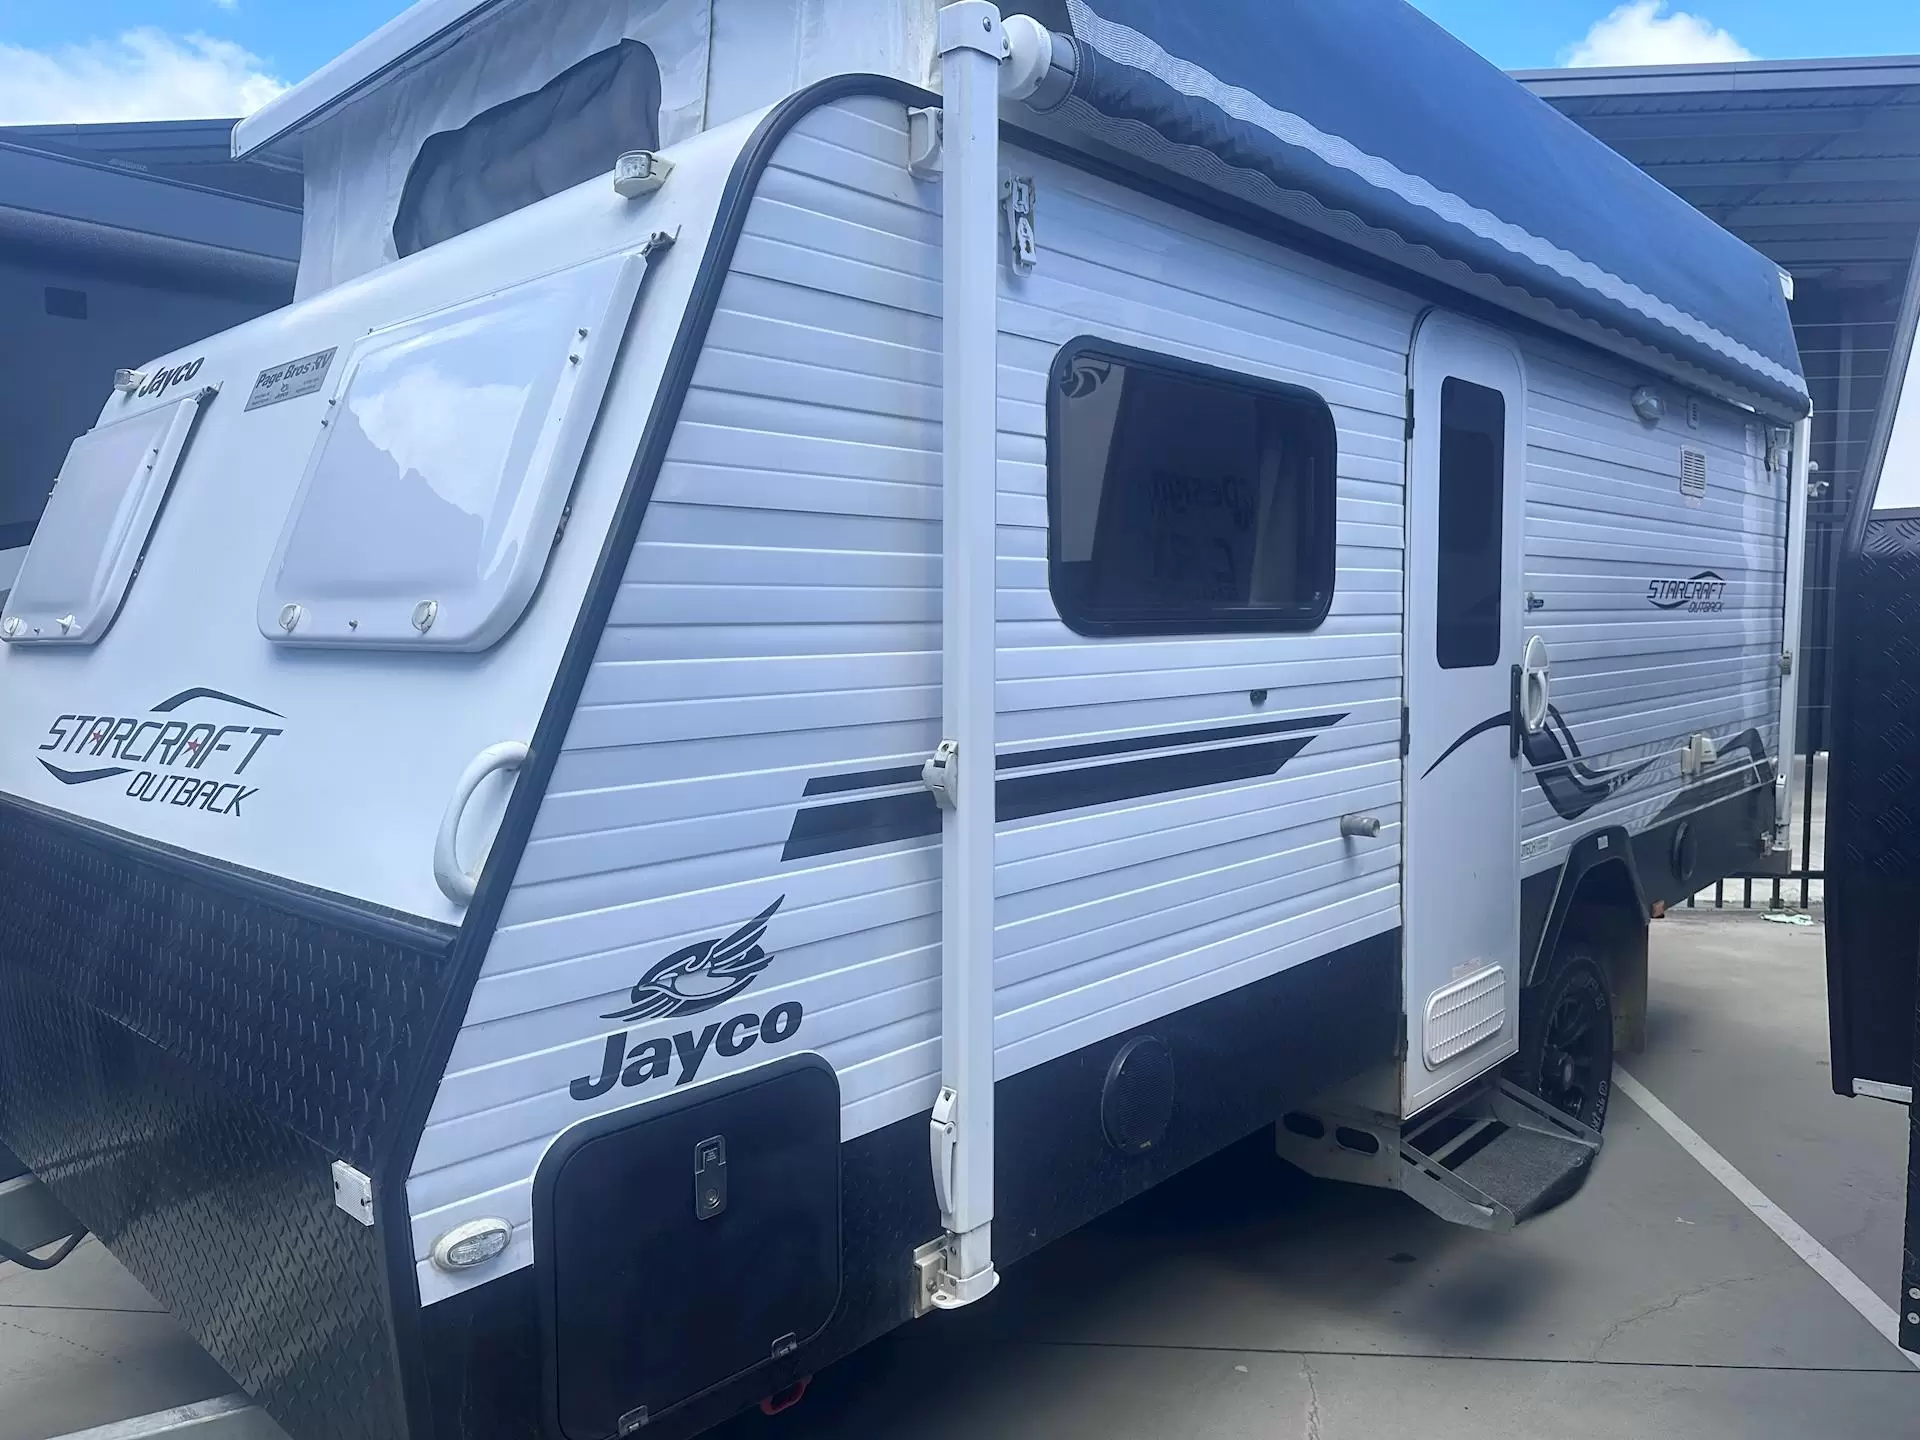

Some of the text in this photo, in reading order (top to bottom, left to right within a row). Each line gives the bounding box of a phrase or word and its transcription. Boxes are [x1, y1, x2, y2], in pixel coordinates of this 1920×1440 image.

[138, 357, 205, 398] Jayco
[256, 373, 283, 389] Page
[283, 364, 311, 381] Bros
[1646, 579, 1727, 600] STARCRAFT
[1688, 601, 1724, 613] OUTBACK
[38, 714, 284, 775] STARCRAFT
[126, 771, 260, 817] OUTBACK
[569, 1001, 804, 1101] Jayco
